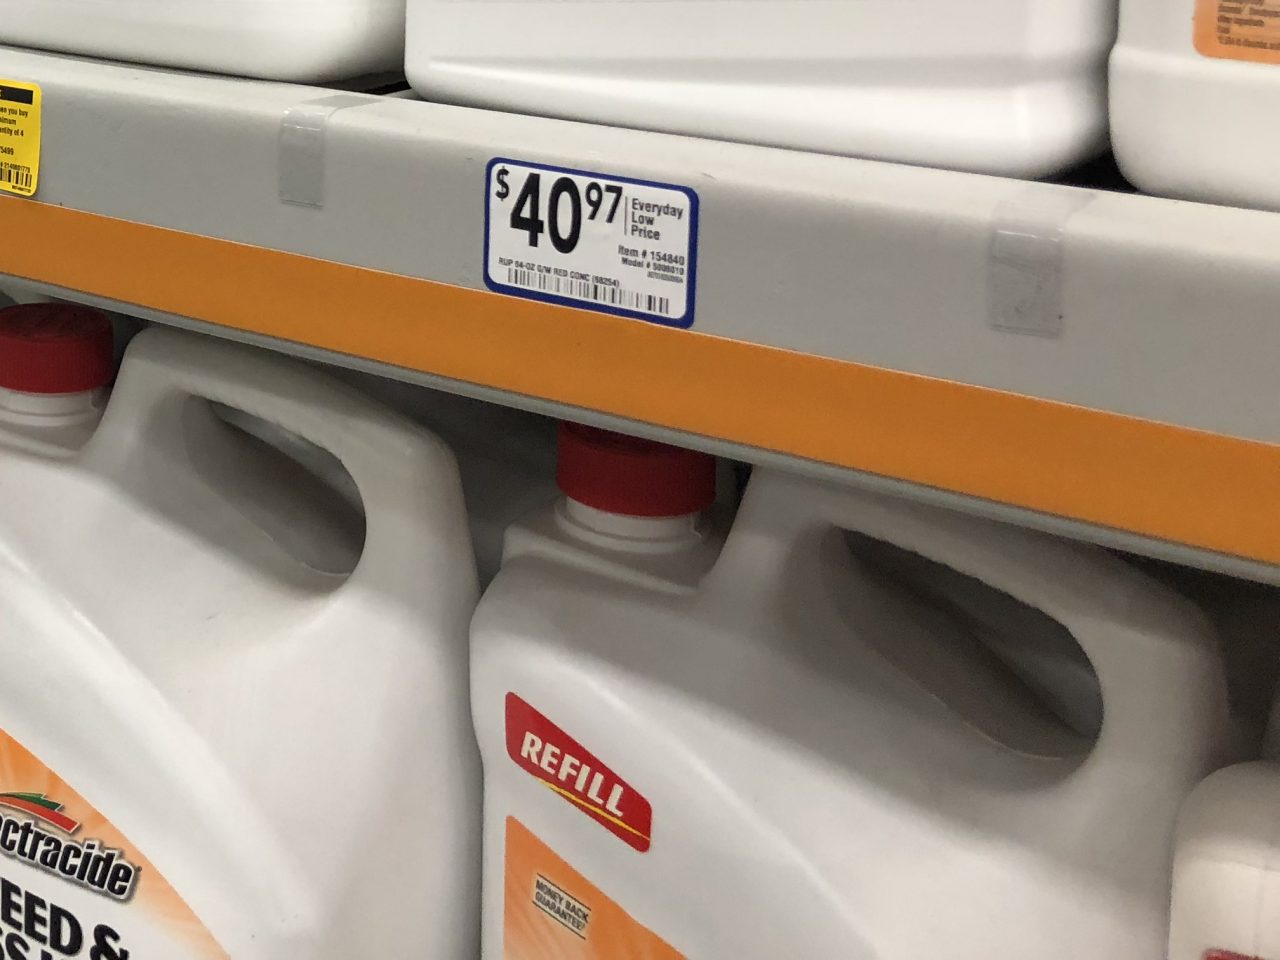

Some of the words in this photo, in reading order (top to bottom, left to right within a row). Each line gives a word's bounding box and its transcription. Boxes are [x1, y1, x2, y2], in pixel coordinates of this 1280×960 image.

[8, 107, 18, 116] you
[19, 108, 29, 118] buy
[13, 128, 20, 137] of
[632, 198, 684, 220] Everyday
[631, 211, 655, 226] Low
[631, 224, 661, 241] Price
[618, 244, 640, 259] Item
[641, 249, 648, 259] #
[520, 730, 624, 818] REFILL
[535, 879, 564, 905] MONEY
[565, 899, 589, 924] BACK
[89, 924, 129, 960] &
